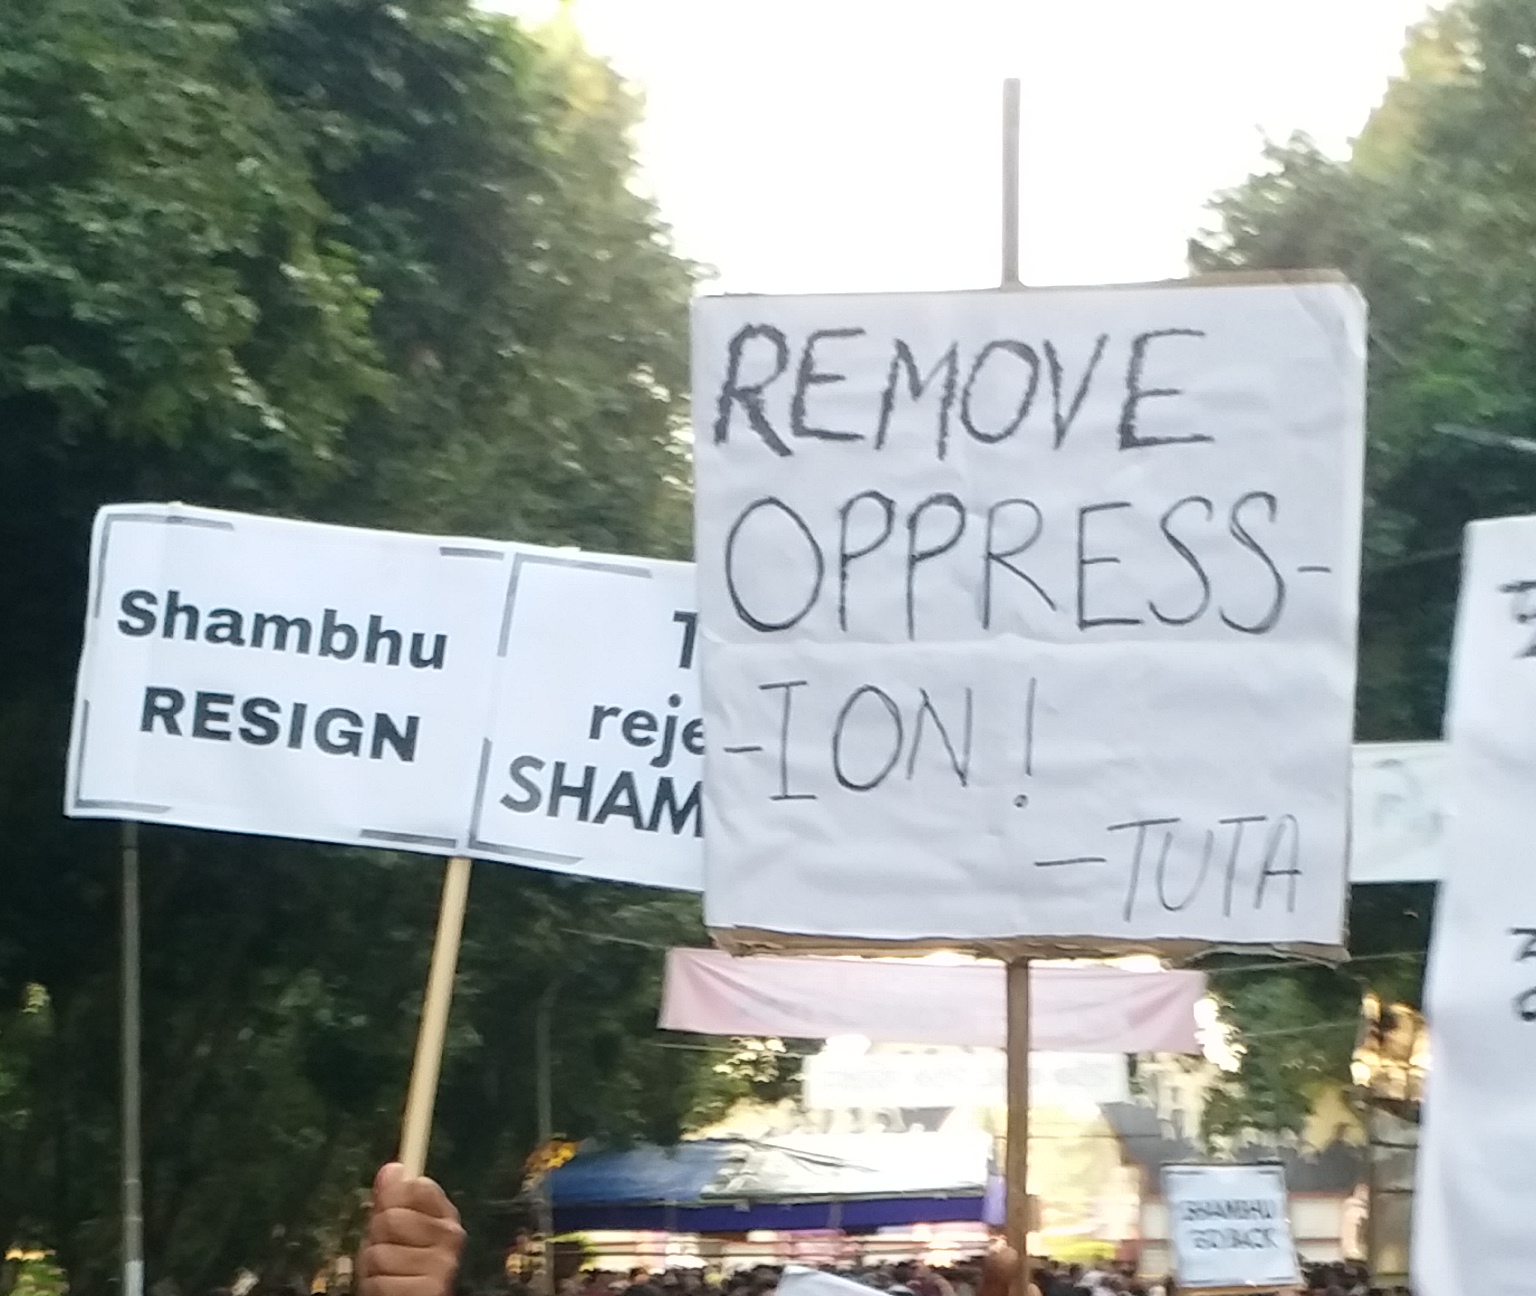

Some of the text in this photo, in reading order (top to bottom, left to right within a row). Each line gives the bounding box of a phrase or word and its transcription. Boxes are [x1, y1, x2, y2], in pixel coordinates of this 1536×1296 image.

[713, 322, 1215, 459] REMOVE
[725, 490, 1332, 640] OPPRESS-
[117, 589, 447, 671] Shambhu
[140, 687, 421, 763] RESIGN
